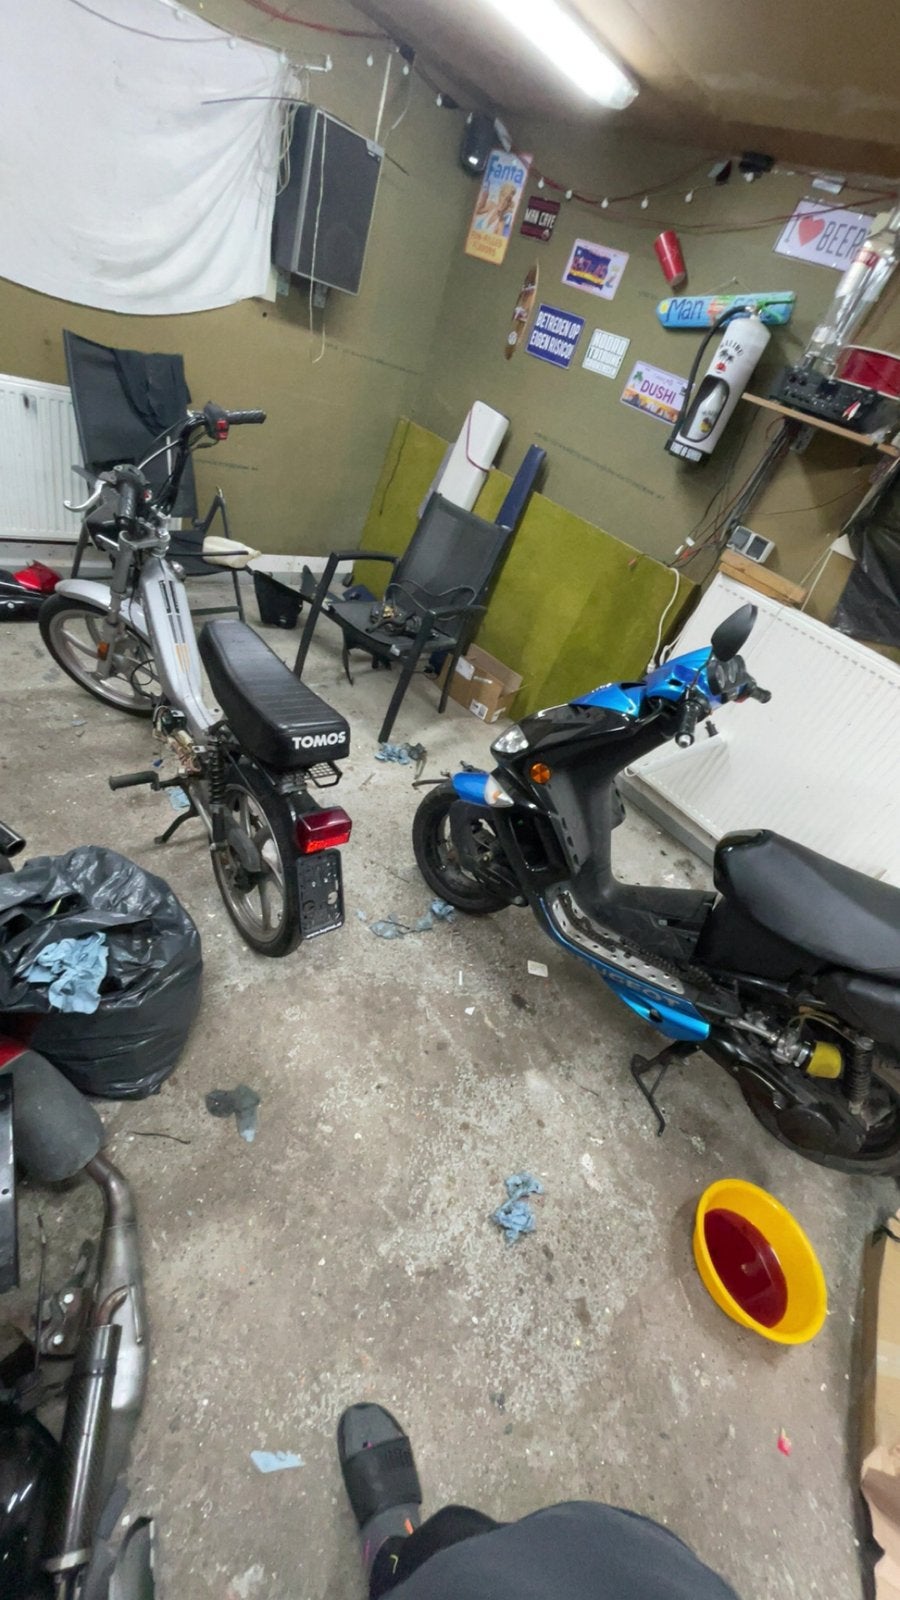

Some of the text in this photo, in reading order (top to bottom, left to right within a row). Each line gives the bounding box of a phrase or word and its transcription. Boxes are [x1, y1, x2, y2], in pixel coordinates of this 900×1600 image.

[485, 154, 524, 184] Fanta
[524, 208, 557, 229] MAN CAVE
[784, 213, 867, 260] I BEER
[665, 297, 704, 322] Man
[535, 311, 581, 340] BETREDEN OP
[529, 330, 551, 351] EIGEN
[640, 379, 677, 405] DUSHI
[292, 731, 346, 750] TOMOS
